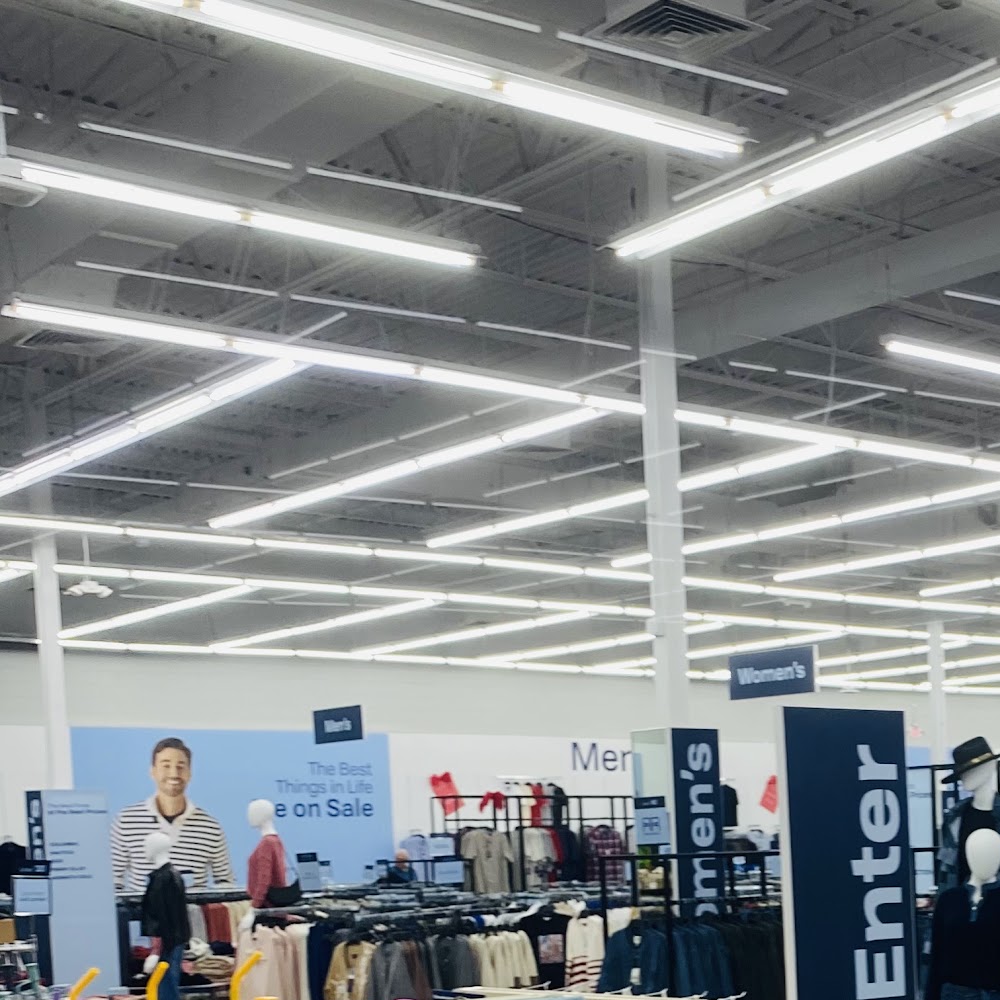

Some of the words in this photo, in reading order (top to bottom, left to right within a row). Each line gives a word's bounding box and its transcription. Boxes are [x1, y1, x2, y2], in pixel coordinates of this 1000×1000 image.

[737, 661, 806, 685] Women's
[307, 761, 335, 776] The
[339, 761, 373, 776] Best
[275, 779, 326, 798] Things
[330, 780, 344, 794] in
[347, 779, 373, 794] Life
[294, 803, 321, 818] on
[326, 798, 374, 818] Sale
[850, 744, 906, 1000] Enter
